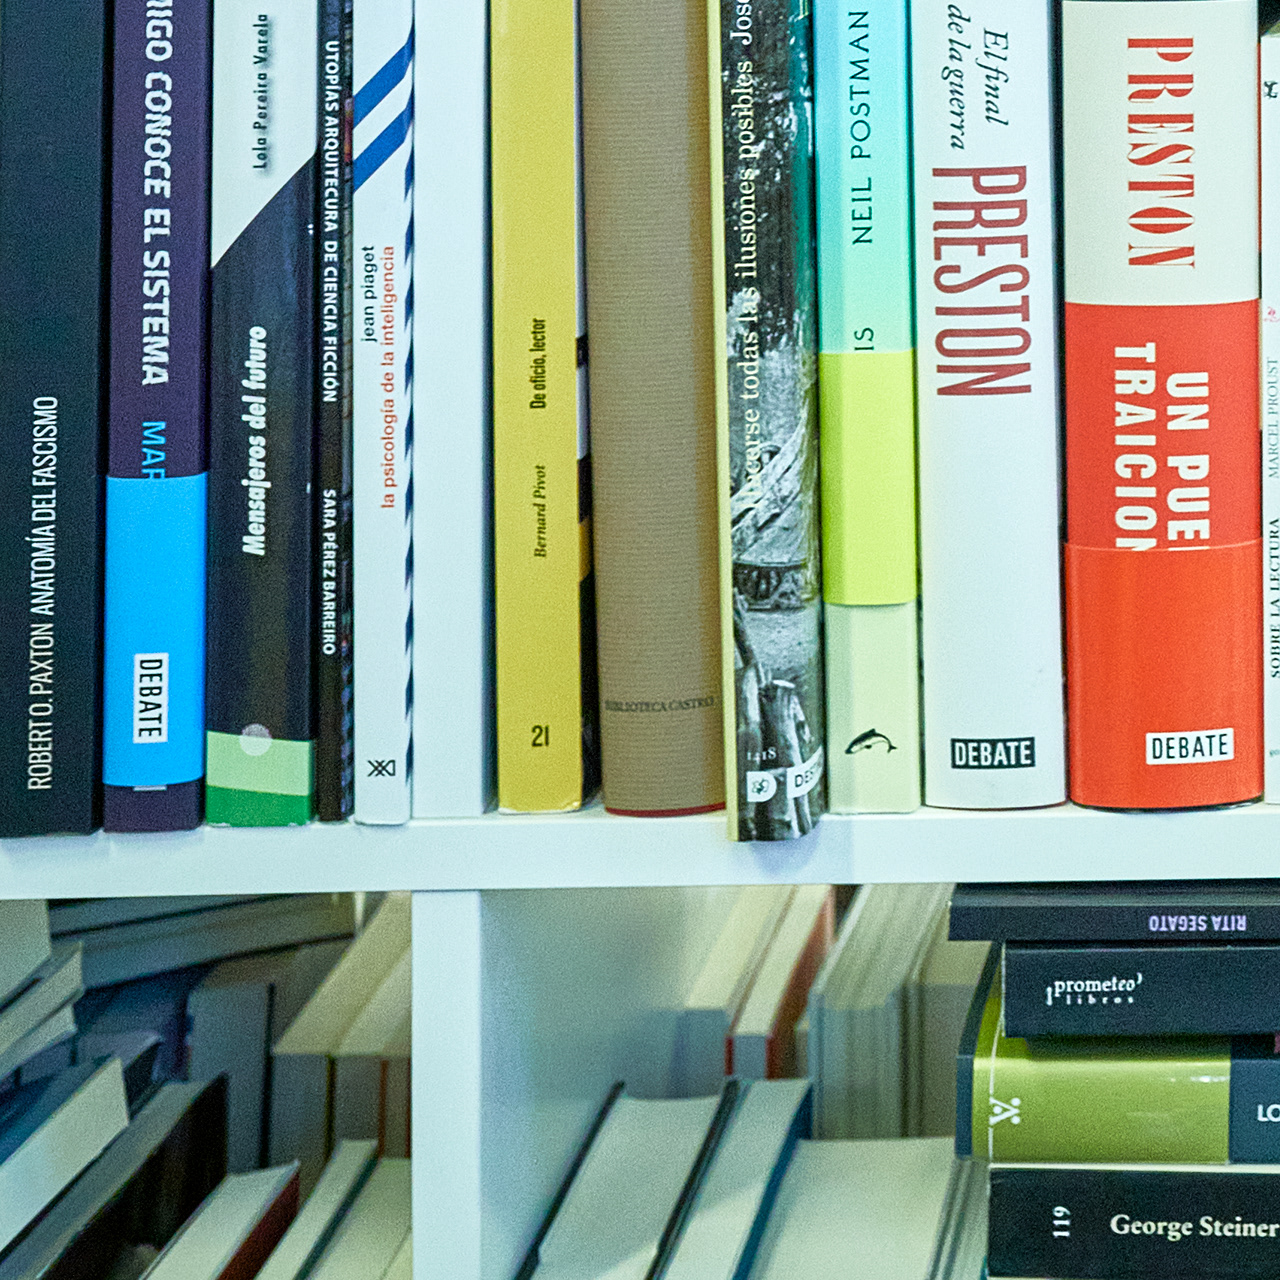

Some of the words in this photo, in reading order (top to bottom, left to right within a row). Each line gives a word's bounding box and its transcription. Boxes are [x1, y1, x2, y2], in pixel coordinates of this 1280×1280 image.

[849, 11, 870, 159] POSTMAN
[143, 71, 173, 199] CONOCE
[1128, 38, 1195, 268] PRESTON
[144, 208, 171, 242] EL
[851, 179, 873, 244] NEIL
[142, 245, 170, 385] SISTEMA
[932, 165, 1032, 397] PRESTON
[242, 326, 266, 397] futuro
[32, 397, 57, 483] FASCISMO
[242, 401, 266, 429] del
[31, 486, 56, 520] DEL
[242, 433, 267, 556] Mensajeros
[322, 489, 335, 527] SARA
[24, 524, 56, 616] ANATOMÍA
[321, 531, 336, 581] PÉREZ
[322, 584, 334, 656] BARREIRO
[29, 623, 55, 695] PAXTON
[28, 698, 54, 717] O.
[138, 660, 162, 737] DEBATE
[27, 719, 53, 790] ROBERT
[955, 741, 1032, 766] DEBATE
[1152, 733, 1228, 760] DEBATE
[1149, 915, 1208, 931] SEGATO
[1211, 915, 1246, 931] RITA
[1053, 1206, 1071, 1238] 119
[1110, 1213, 1192, 1240] George
[1199, 1216, 1279, 1237] Steiner
